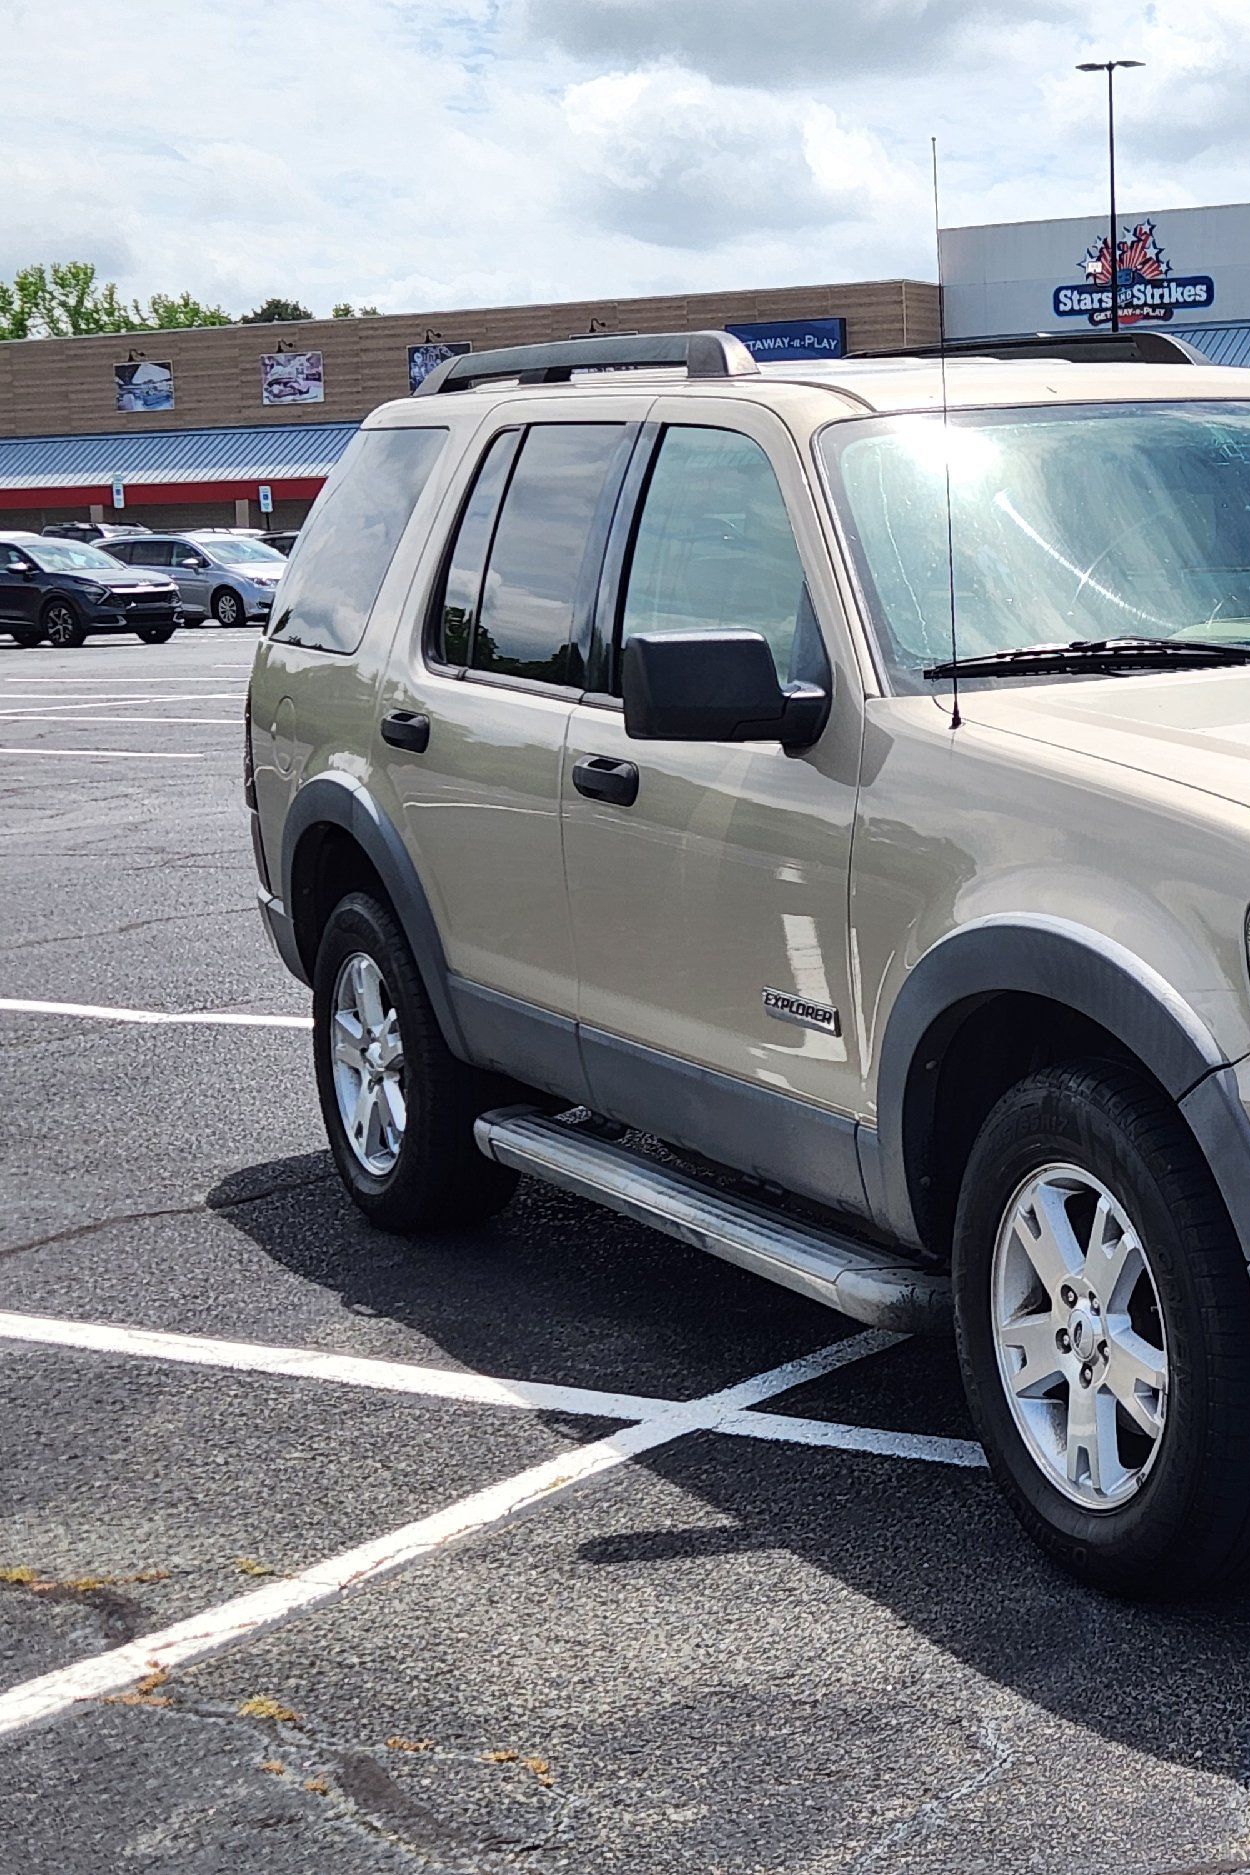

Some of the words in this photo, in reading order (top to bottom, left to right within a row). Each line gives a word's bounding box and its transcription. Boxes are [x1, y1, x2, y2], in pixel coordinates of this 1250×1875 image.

[1059, 289, 1113, 312] Stars
[1133, 281, 1208, 306] Strikes
[746, 335, 838, 351] TAWAY-n-PLAY
[764, 992, 832, 1025] EXPLORER
